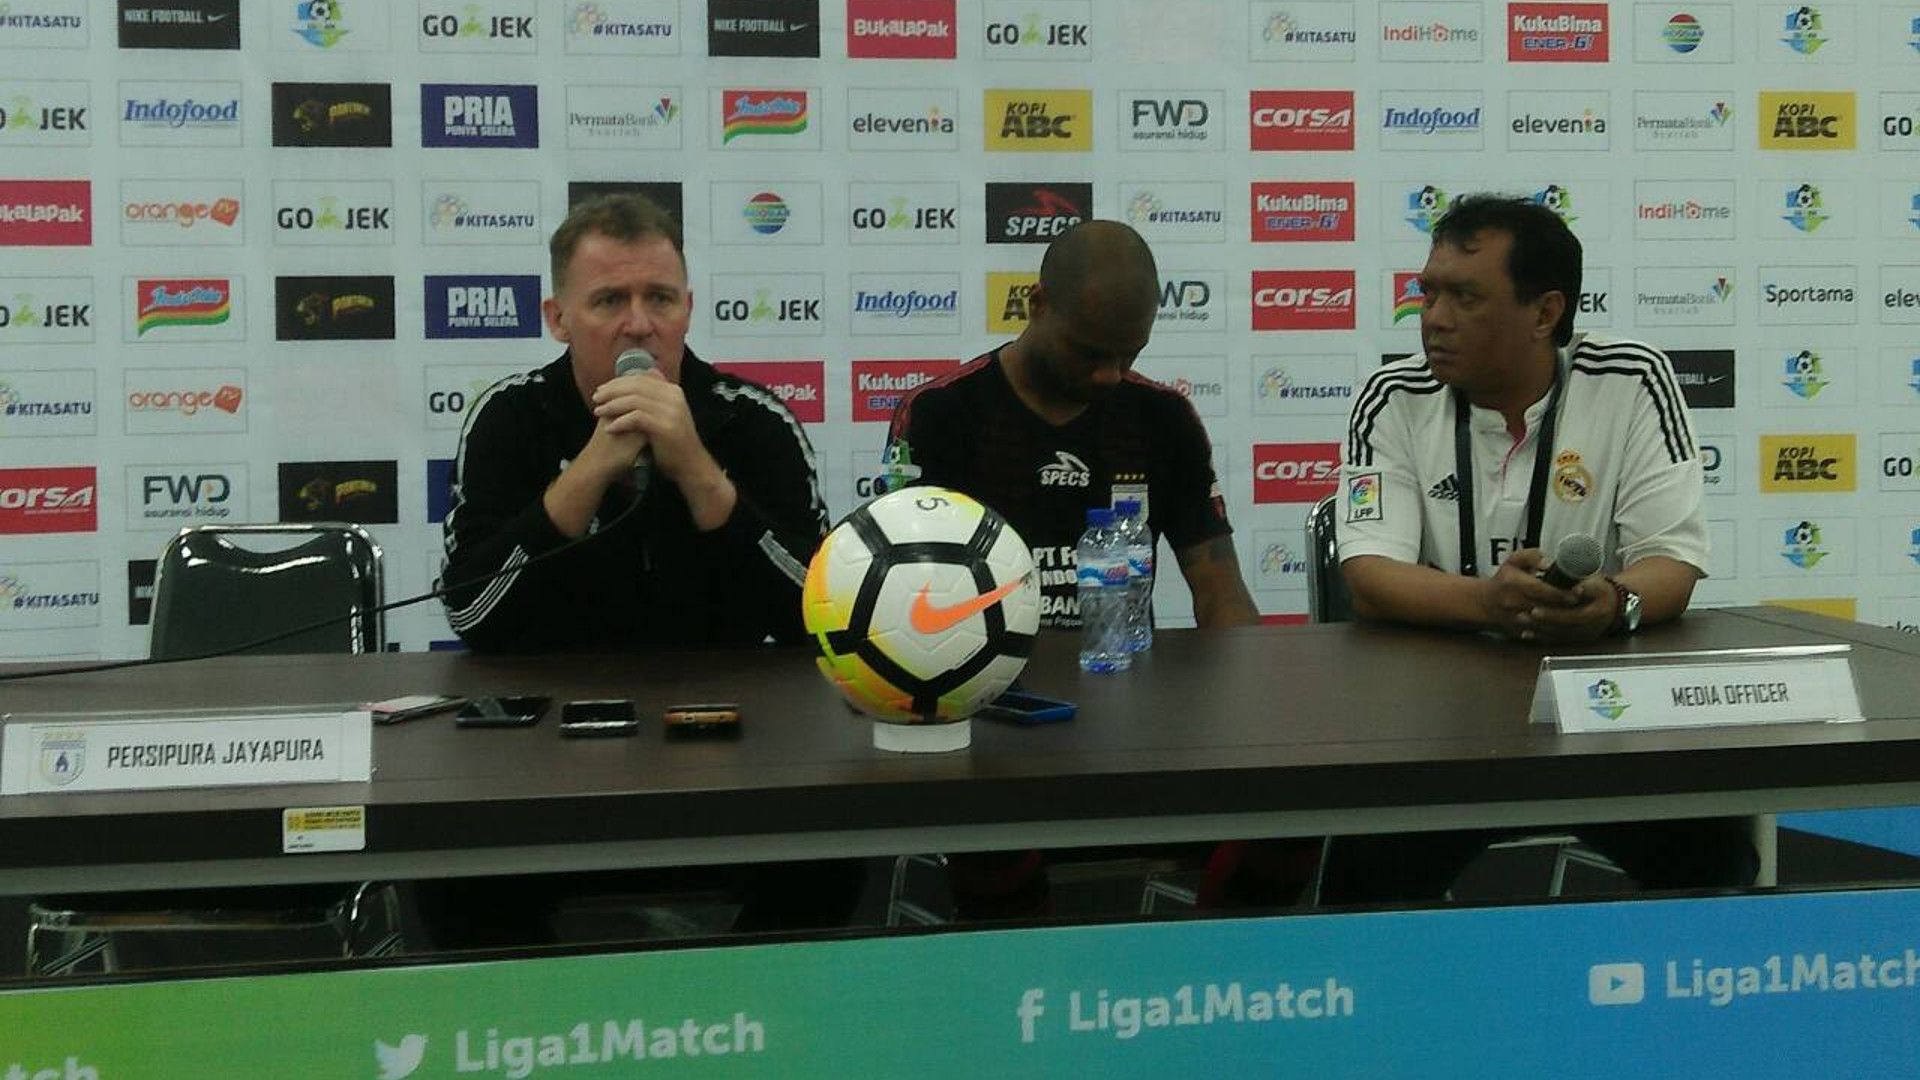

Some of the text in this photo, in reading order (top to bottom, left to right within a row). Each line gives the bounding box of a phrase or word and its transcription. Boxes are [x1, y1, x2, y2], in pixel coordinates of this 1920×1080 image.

[124, 8, 203, 23] NIKE FOOTBALL
[714, 19, 785, 32] NIKE FOOTBALL
[1514, 15, 1602, 33] KukuBima
[423, 15, 533, 38] GO JEK
[594, 22, 671, 37] #KITASATU
[986, 24, 1087, 45] GO JEK
[1285, 29, 1356, 44] #KITASATU
[1383, 23, 1478, 42] IndiHome
[39, 107, 87, 131] JEK
[124, 98, 237, 128] Indofood
[445, 96, 513, 125] PRIA
[1006, 102, 1045, 116] KOPI
[1132, 100, 1208, 127] FWD
[1779, 104, 1815, 115] KOPI
[570, 112, 658, 127] PermataBank
[853, 107, 954, 134] elevenia
[1001, 115, 1072, 139] ABC
[1383, 108, 1479, 135] Indofood
[1512, 108, 1606, 134] elevenia
[1774, 116, 1838, 138] ABC
[1884, 117, 1912, 136] GO
[445, 125, 516, 137] PUNYA SELERA
[1177, 128, 1207, 140] hidup
[1257, 195, 1348, 213] KukuBima
[1638, 201, 1730, 220] IndiHome
[125, 202, 208, 228] orange
[278, 208, 389, 230] GO JEK
[455, 213, 534, 228] #KITASATU
[853, 208, 955, 229] GO JEK
[1149, 210, 1221, 225] #KITASATU
[448, 287, 516, 316] PRIA
[1008, 285, 1034, 299] KO
[1159, 280, 1211, 308] WD
[1765, 284, 1853, 307] Sportama
[1885, 288, 1920, 308] elev
[715, 300, 820, 321] GO JEK
[854, 291, 957, 319] Indofood
[1580, 293, 1607, 313] EK
[43, 305, 90, 328] JEK
[448, 315, 519, 328] PUNYA SELERA
[129, 389, 213, 415] orange
[430, 392, 464, 413] GO
[1281, 387, 1351, 399] #KITASATU
[6, 402, 91, 416] #KITASATU
[1779, 447, 1814, 458] KOPI
[1774, 458, 1837, 480] ABC
[1884, 457, 1912, 477] GO
[1040, 470, 1090, 487] SPECS
[144, 474, 230, 504] FWD
[1354, 508, 1374, 519] LFP
[1034, 548, 1058, 567] PT
[1041, 570, 1078, 587] NDO
[13, 591, 99, 607] #KITASATU
[1040, 595, 1080, 615] BAN
[1672, 682, 1788, 706] MEDIA OFFICER
[108, 739, 324, 769] PERSIPURA JAYAPURA
[1665, 952, 1920, 1006] Liga1Match
[1068, 979, 1354, 1041] Liga1Match
[456, 1012, 765, 1079] Liga1Match
